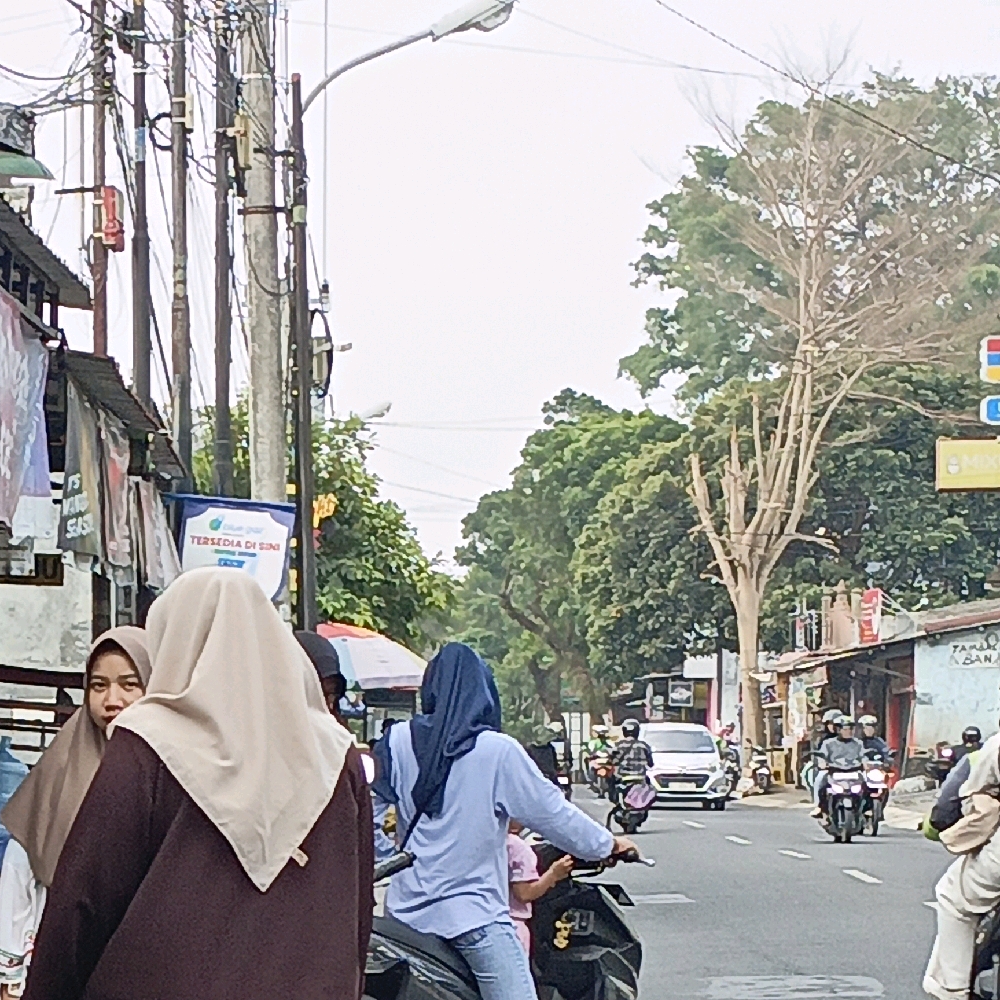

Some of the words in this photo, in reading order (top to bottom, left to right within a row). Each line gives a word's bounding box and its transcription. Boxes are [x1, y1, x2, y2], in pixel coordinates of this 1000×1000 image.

[190, 535, 243, 548] TERSEDIA
[244, 540, 256, 550] DI
[258, 542, 281, 551] SINI
